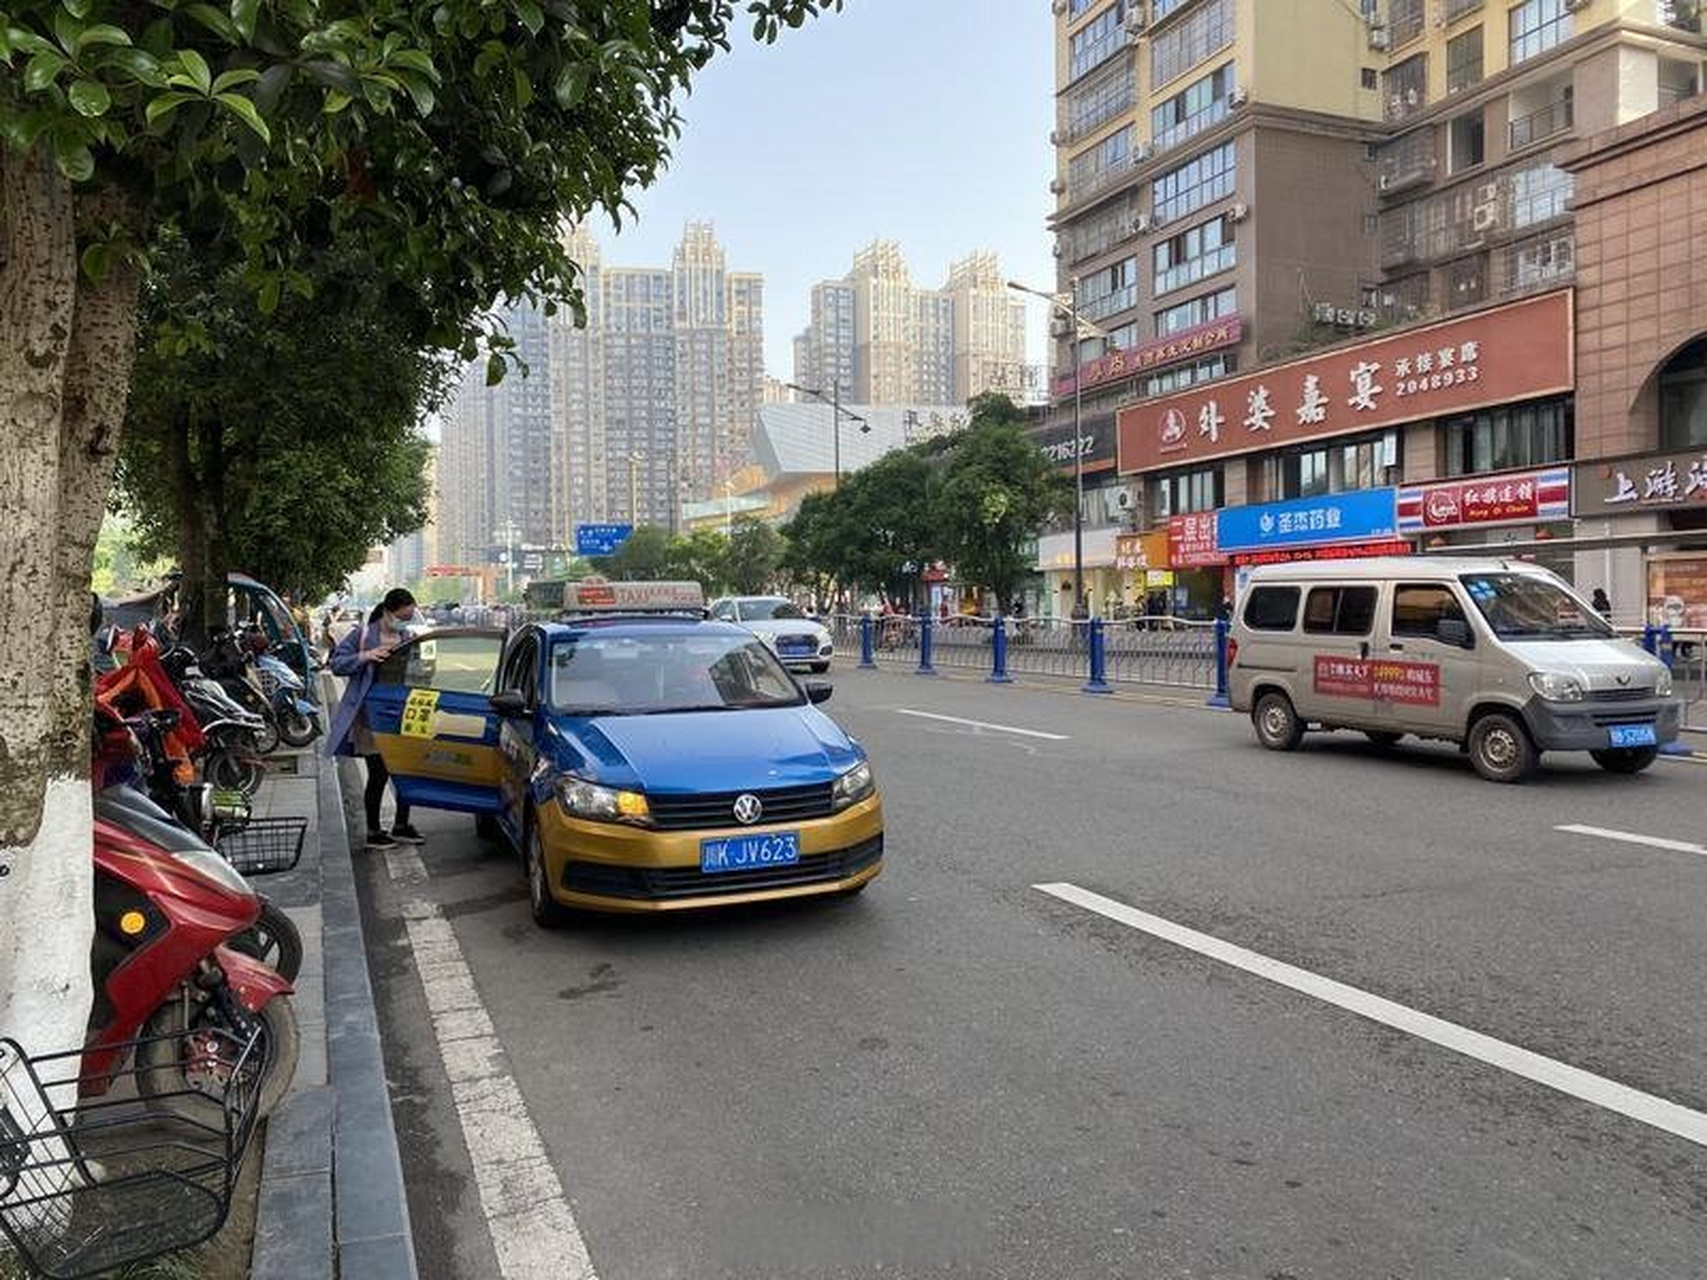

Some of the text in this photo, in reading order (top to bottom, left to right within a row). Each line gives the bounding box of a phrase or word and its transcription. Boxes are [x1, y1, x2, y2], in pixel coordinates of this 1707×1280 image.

[1396, 366, 1479, 396] 2048933
[1198, 361, 1384, 442] 外婆嘉宴
[1463, 481, 1534, 507] 红旗连锁
